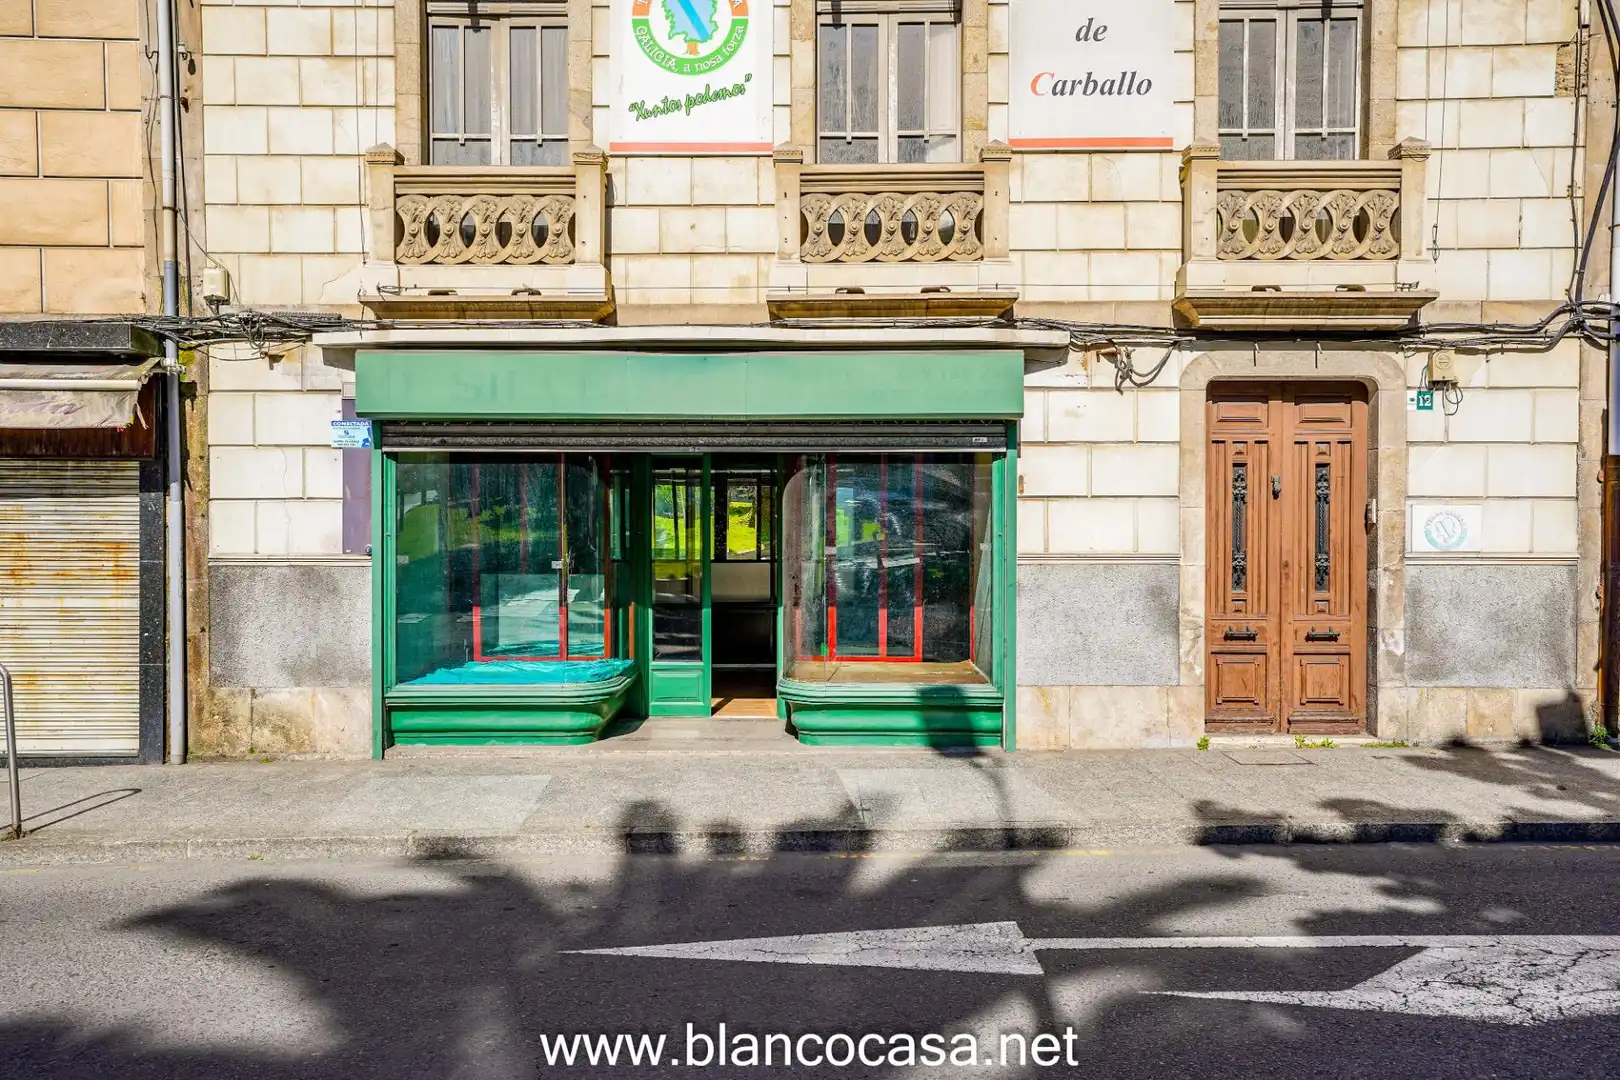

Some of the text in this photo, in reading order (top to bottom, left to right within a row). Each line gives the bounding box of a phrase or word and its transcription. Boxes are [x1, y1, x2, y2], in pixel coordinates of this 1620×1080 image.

[1075, 17, 1108, 42] de
[683, 63, 691, 73] a
[695, 55, 724, 71] nosa
[725, 25, 745, 57] forza
[1030, 71, 1153, 96] Carballo
[1419, 395, 1431, 406] 12
